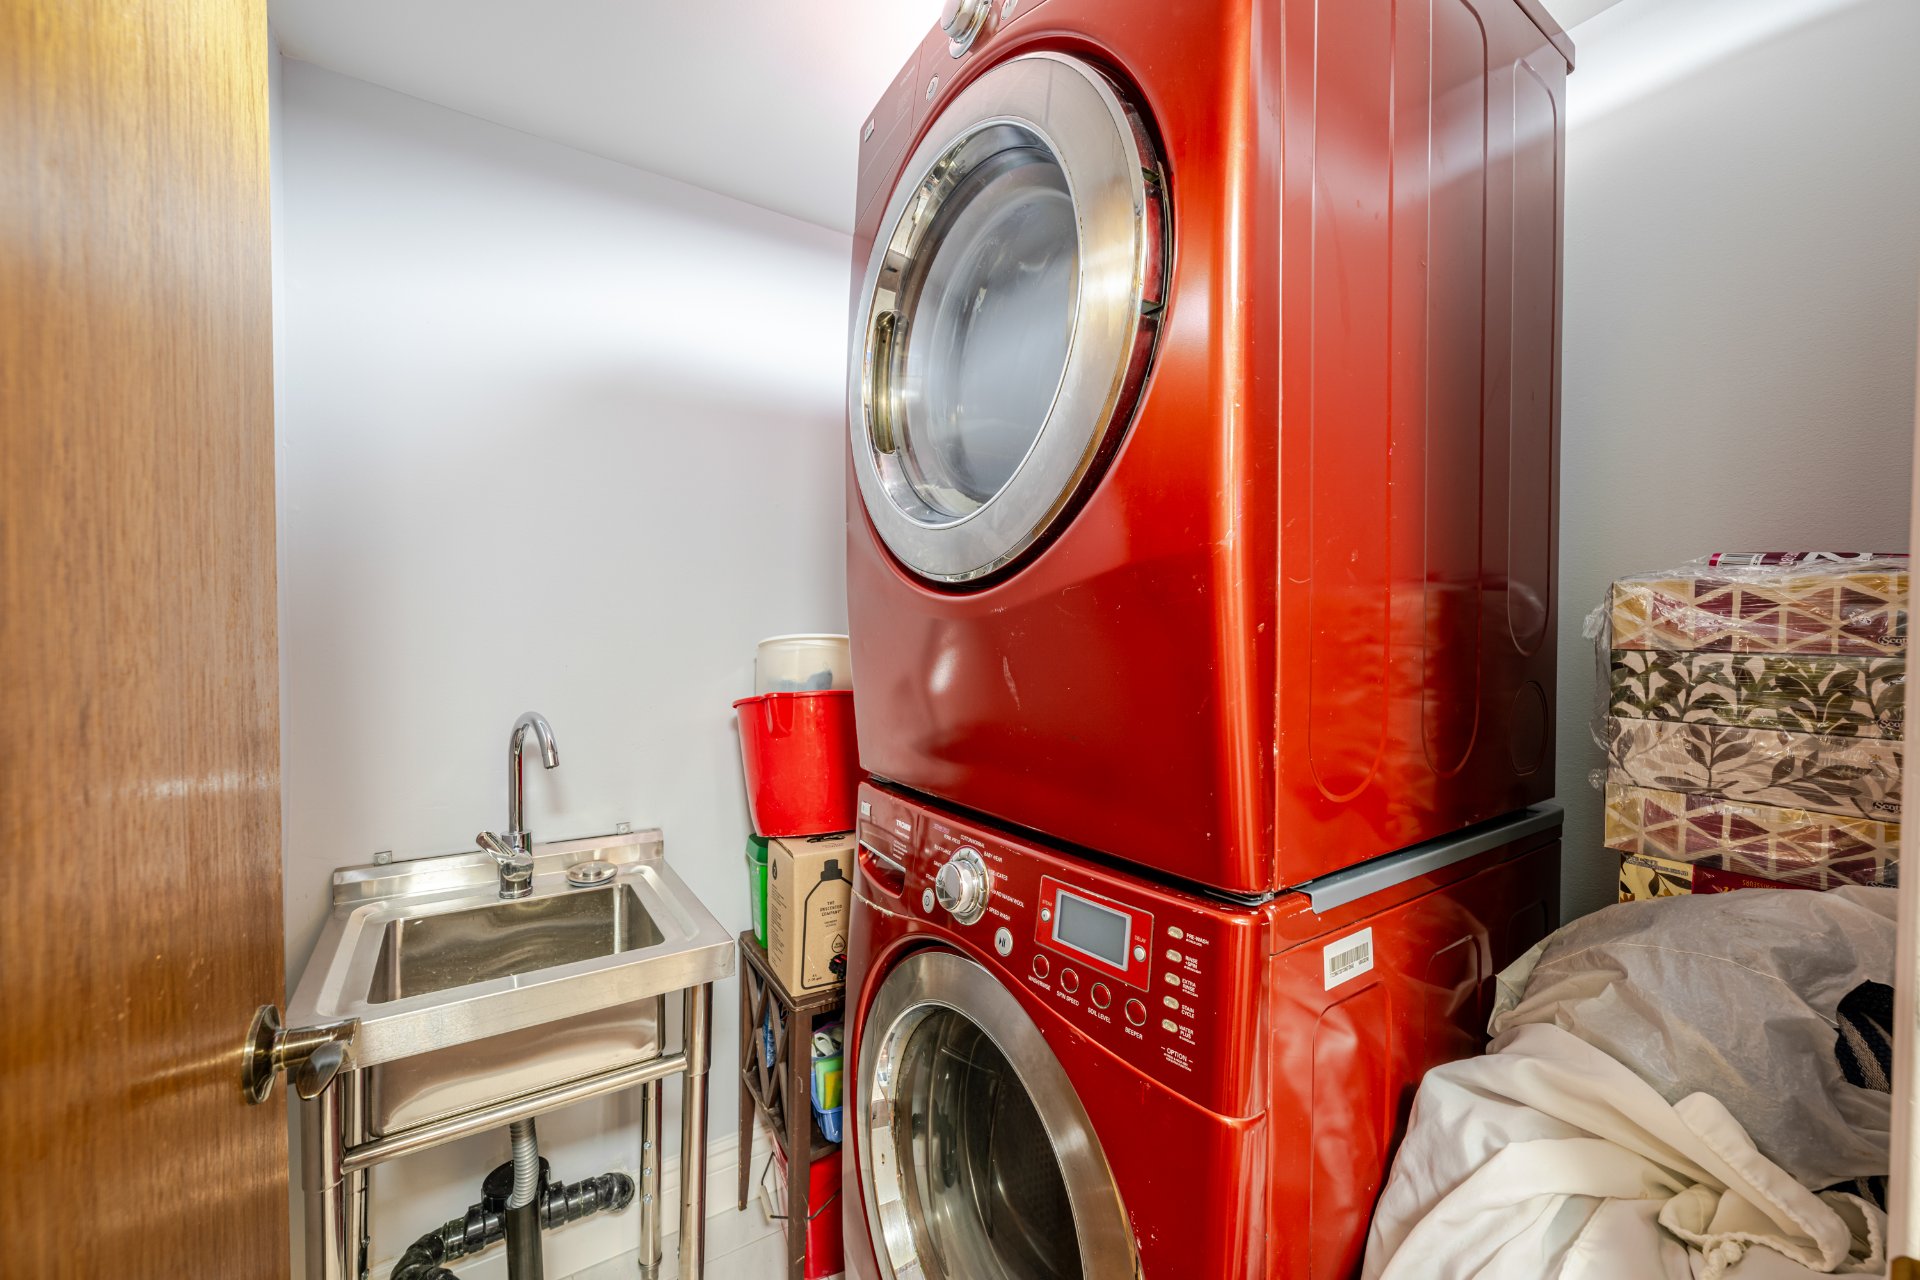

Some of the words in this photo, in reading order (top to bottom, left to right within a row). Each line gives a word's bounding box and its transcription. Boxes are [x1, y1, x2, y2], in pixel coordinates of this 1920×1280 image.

[1056, 990, 1067, 1000] SPIN
[1066, 995, 1080, 1007] SPEED
[1087, 1007, 1098, 1017] SOIL
[1098, 1012, 1111, 1024] LEVEL
[1124, 1026, 1143, 1040] BEEPER
[1166, 1047, 1188, 1062] OPTION
